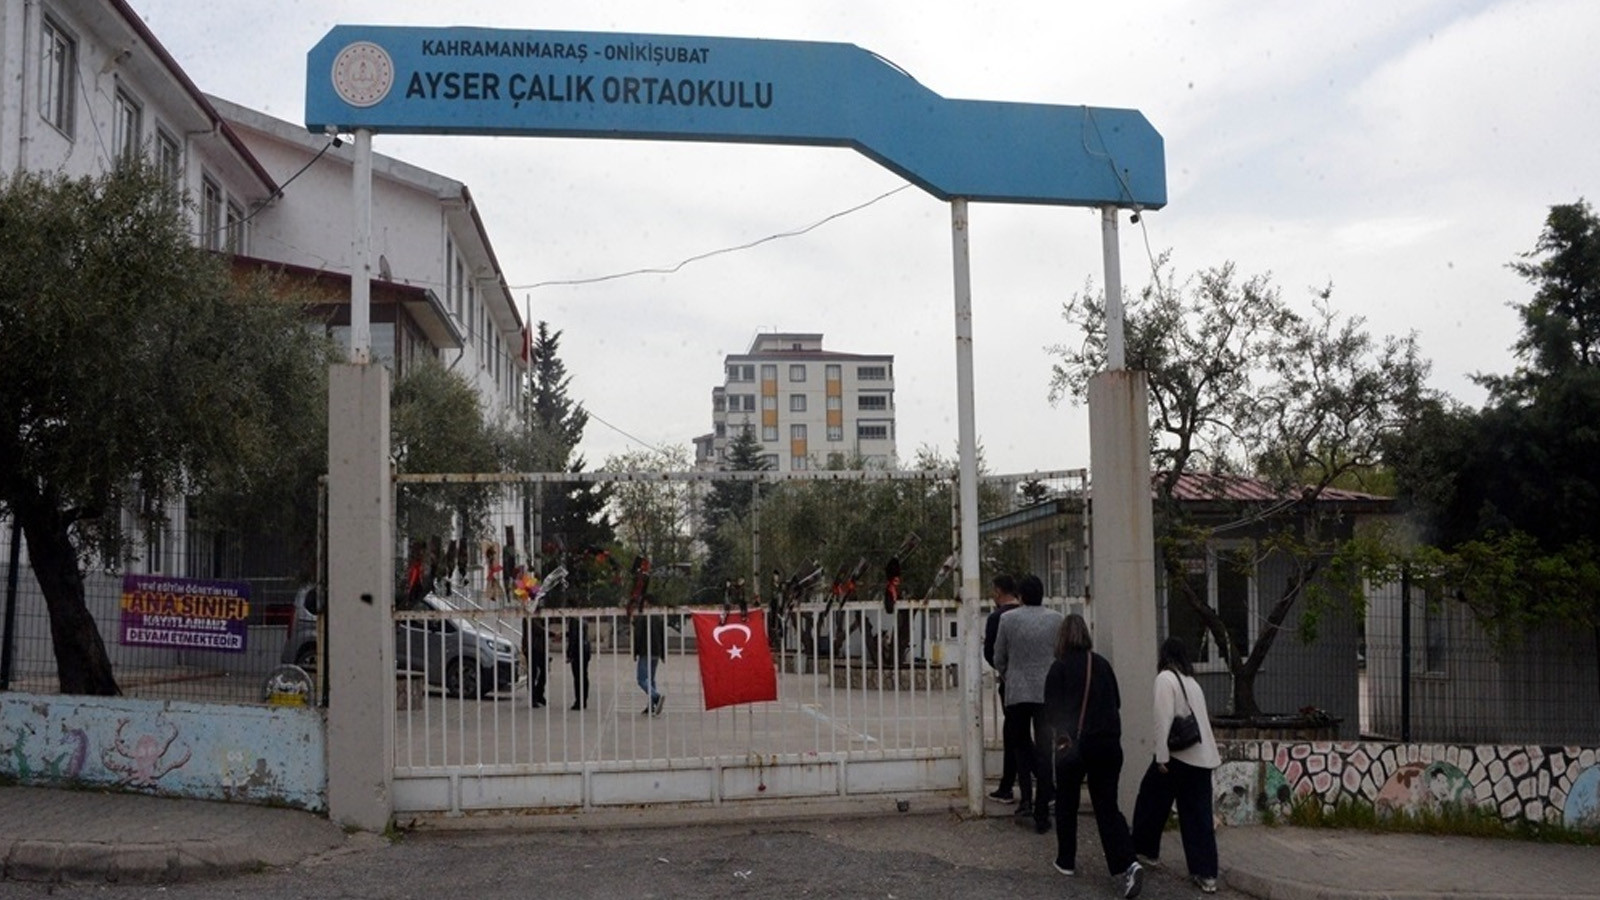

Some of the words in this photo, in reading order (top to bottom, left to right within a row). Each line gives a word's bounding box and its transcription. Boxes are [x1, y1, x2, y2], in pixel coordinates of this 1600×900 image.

[422, 40, 587, 63] KAHRAMANMARAŞ
[604, 42, 709, 66] ONİKİŞUBAT
[406, 71, 500, 101] AYSER
[508, 74, 594, 109] ÇALIK
[602, 77, 773, 109] ORTAOKULU
[128, 592, 177, 613] ANA
[180, 595, 245, 619] SINIFI
[143, 615, 227, 630] KAYITLARIMIZ
[129, 629, 169, 642] DEVAM
[170, 632, 239, 647] ETMEKTEDİR
